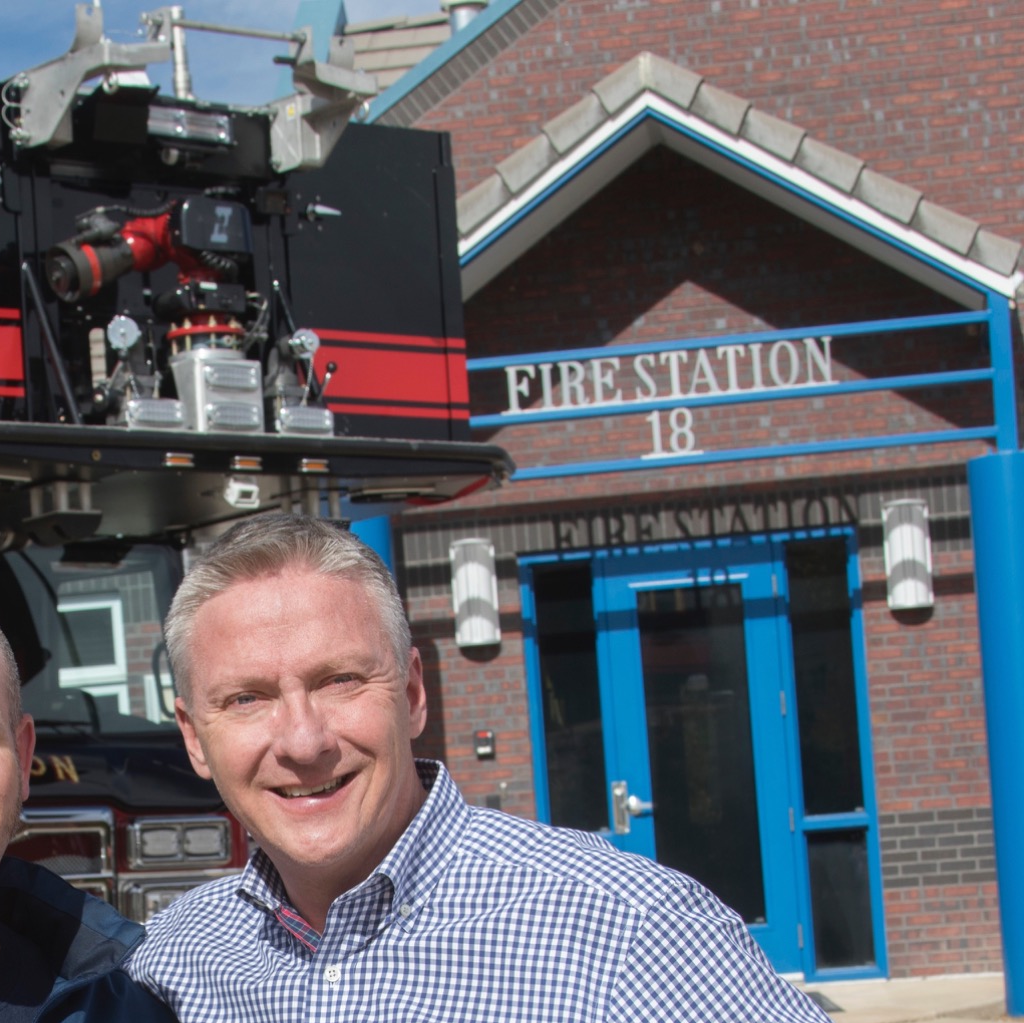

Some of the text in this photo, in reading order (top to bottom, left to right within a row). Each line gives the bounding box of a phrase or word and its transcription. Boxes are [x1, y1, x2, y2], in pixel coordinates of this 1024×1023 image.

[502, 336, 838, 416] FIRE STATION
[644, 407, 697, 456] 18
